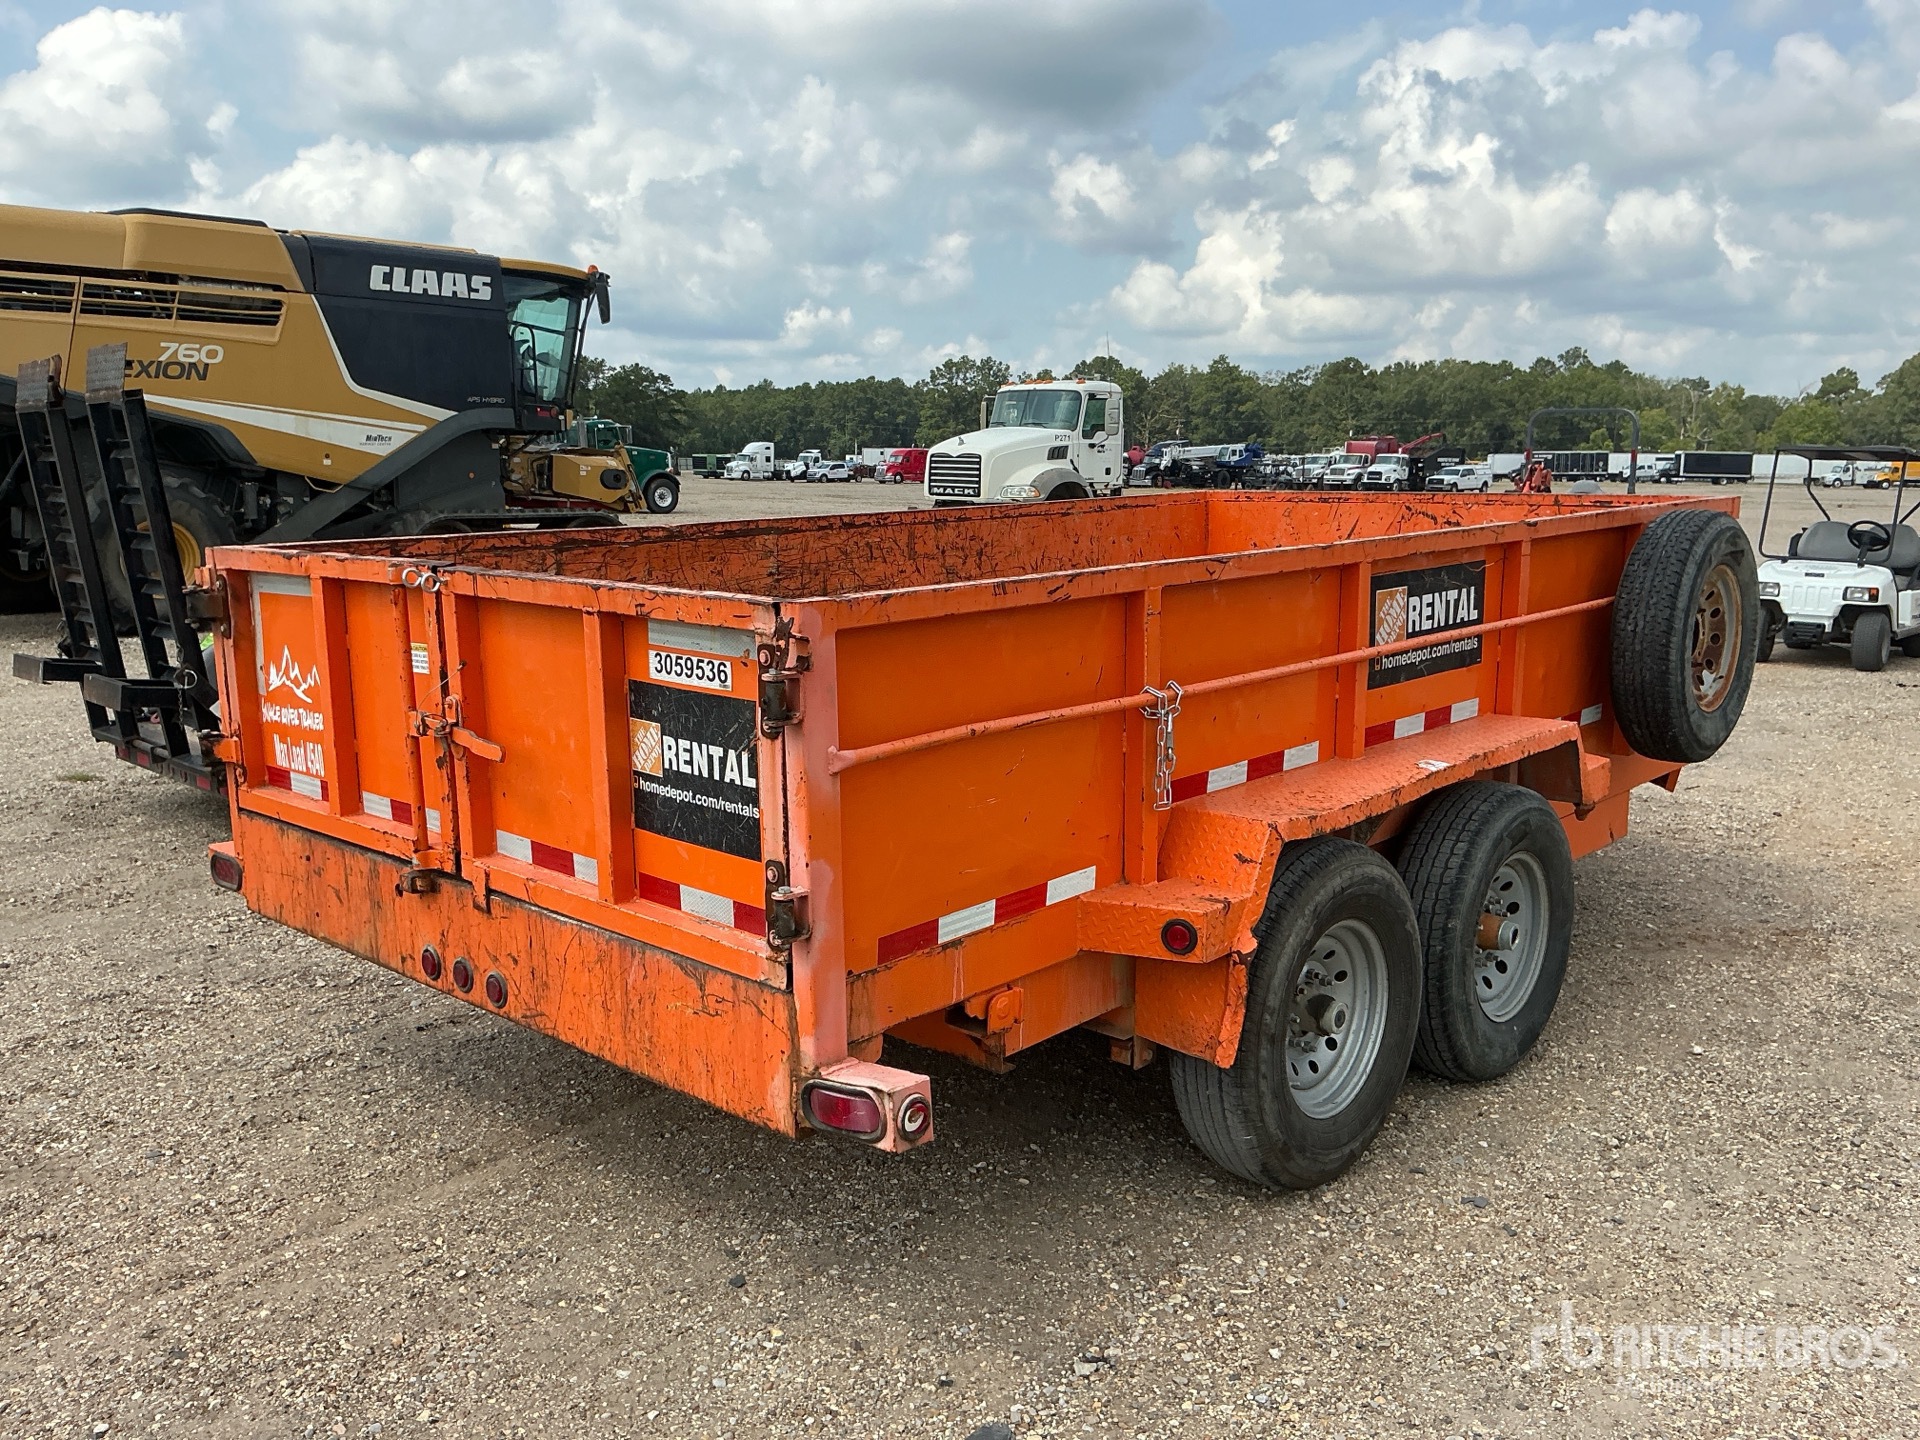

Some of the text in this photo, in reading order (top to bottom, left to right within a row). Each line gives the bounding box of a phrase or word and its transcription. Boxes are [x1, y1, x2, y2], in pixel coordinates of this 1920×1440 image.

[369, 264, 492, 301] CLAAS
[124, 359, 209, 381] EXION
[158, 342, 224, 364] 760
[1054, 434, 1071, 442] P271
[933, 487, 975, 495] MACK
[1408, 586, 1478, 633] RENTAL
[654, 652, 729, 684] 3059536
[1382, 637, 1478, 671] homedepot.com/rentals
[632, 724, 660, 771] HOME
[634, 726, 646, 746] THE
[287, 736, 306, 773] Load
[662, 735, 757, 789] RENTAL
[639, 777, 760, 819] homedepot.com/rentals
